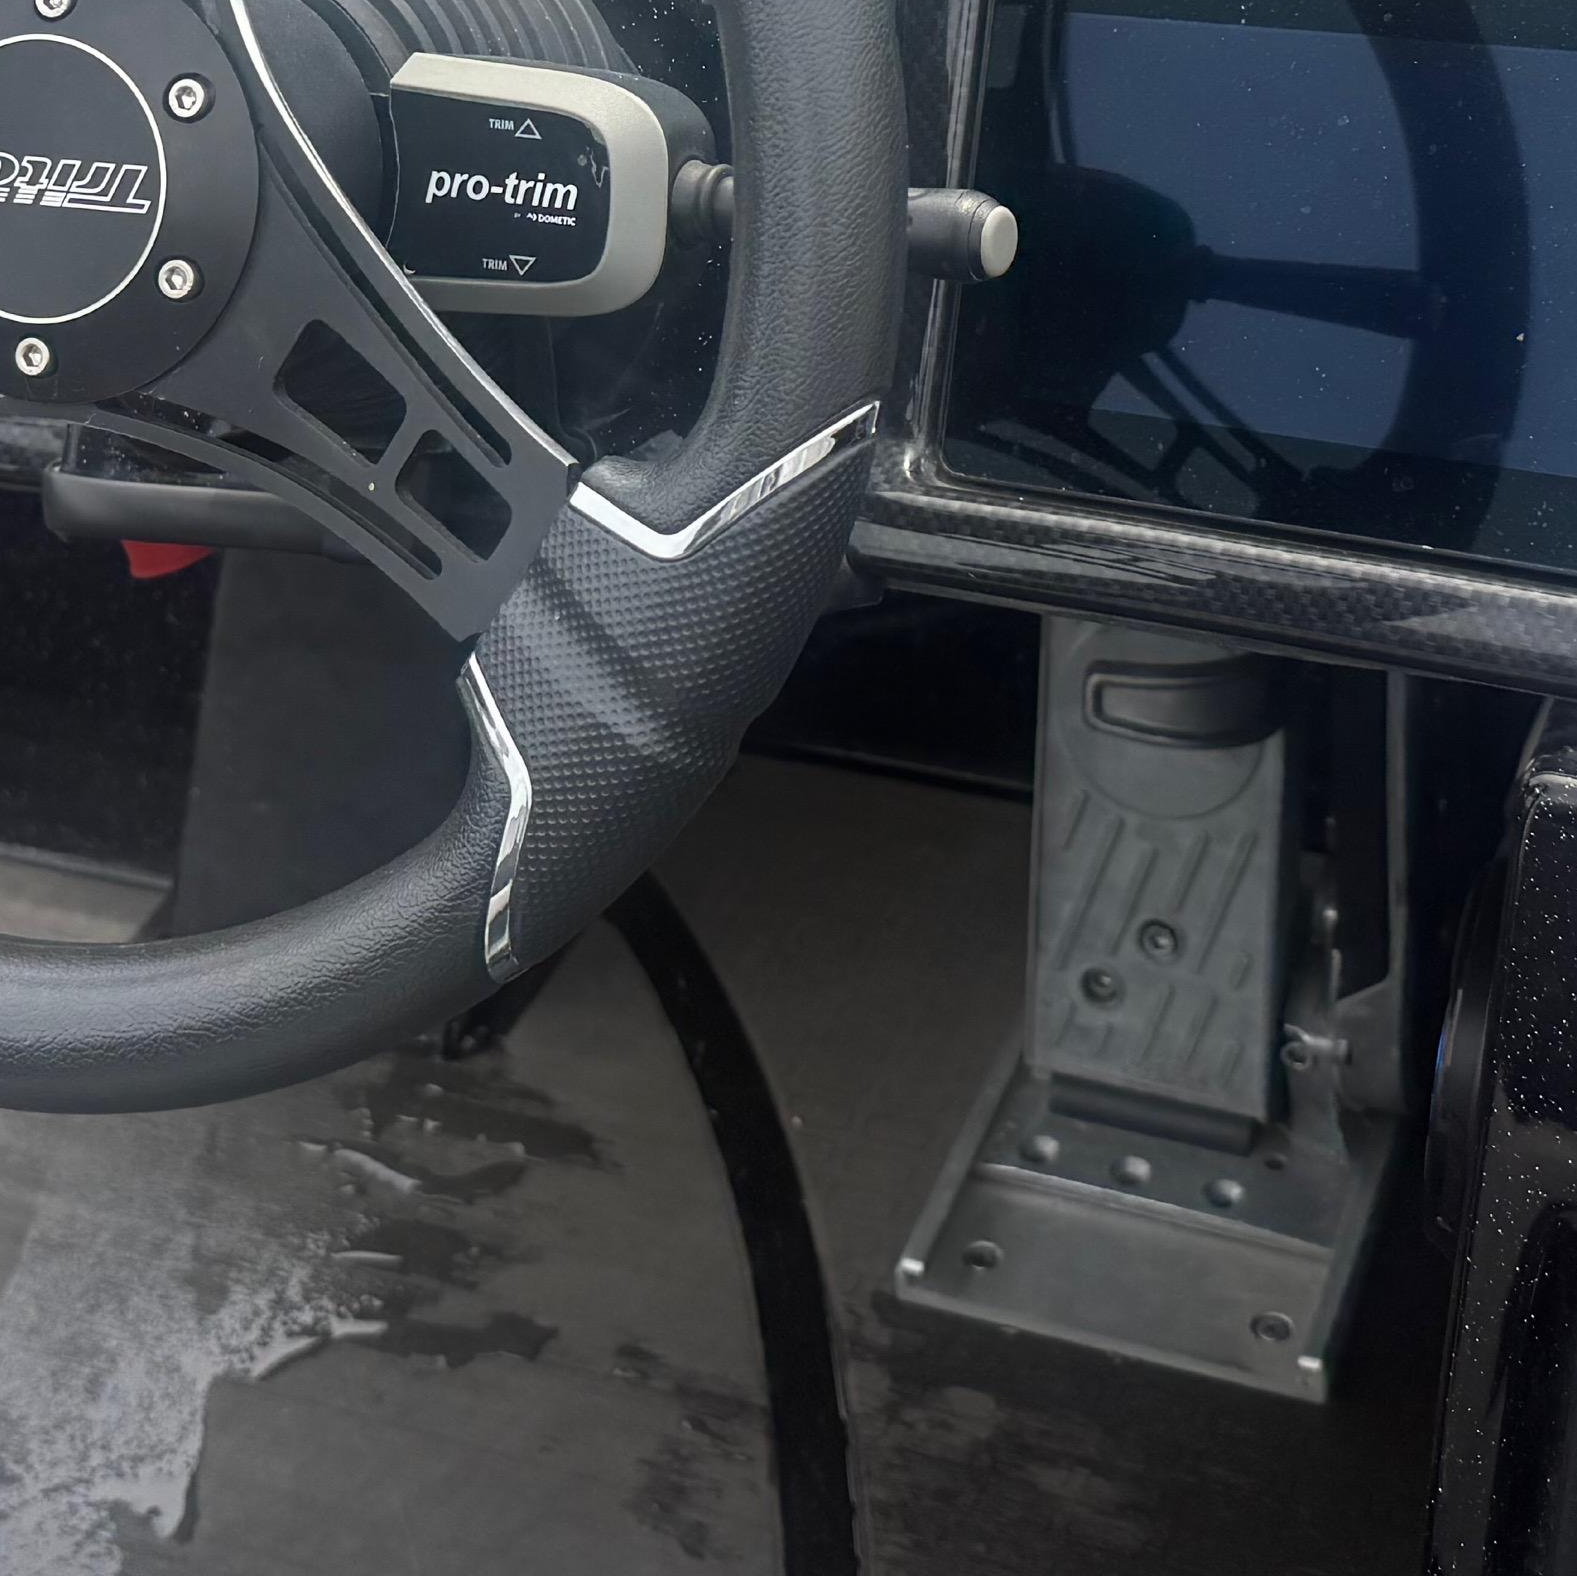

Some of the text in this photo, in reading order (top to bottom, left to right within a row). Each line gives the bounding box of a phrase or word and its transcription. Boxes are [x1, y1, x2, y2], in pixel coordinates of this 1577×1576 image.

[489, 118, 514, 132] TRIM
[425, 168, 578, 211] pro-trim
[538, 213, 576, 227] DOMETIC
[482, 257, 508, 272] TRIM
